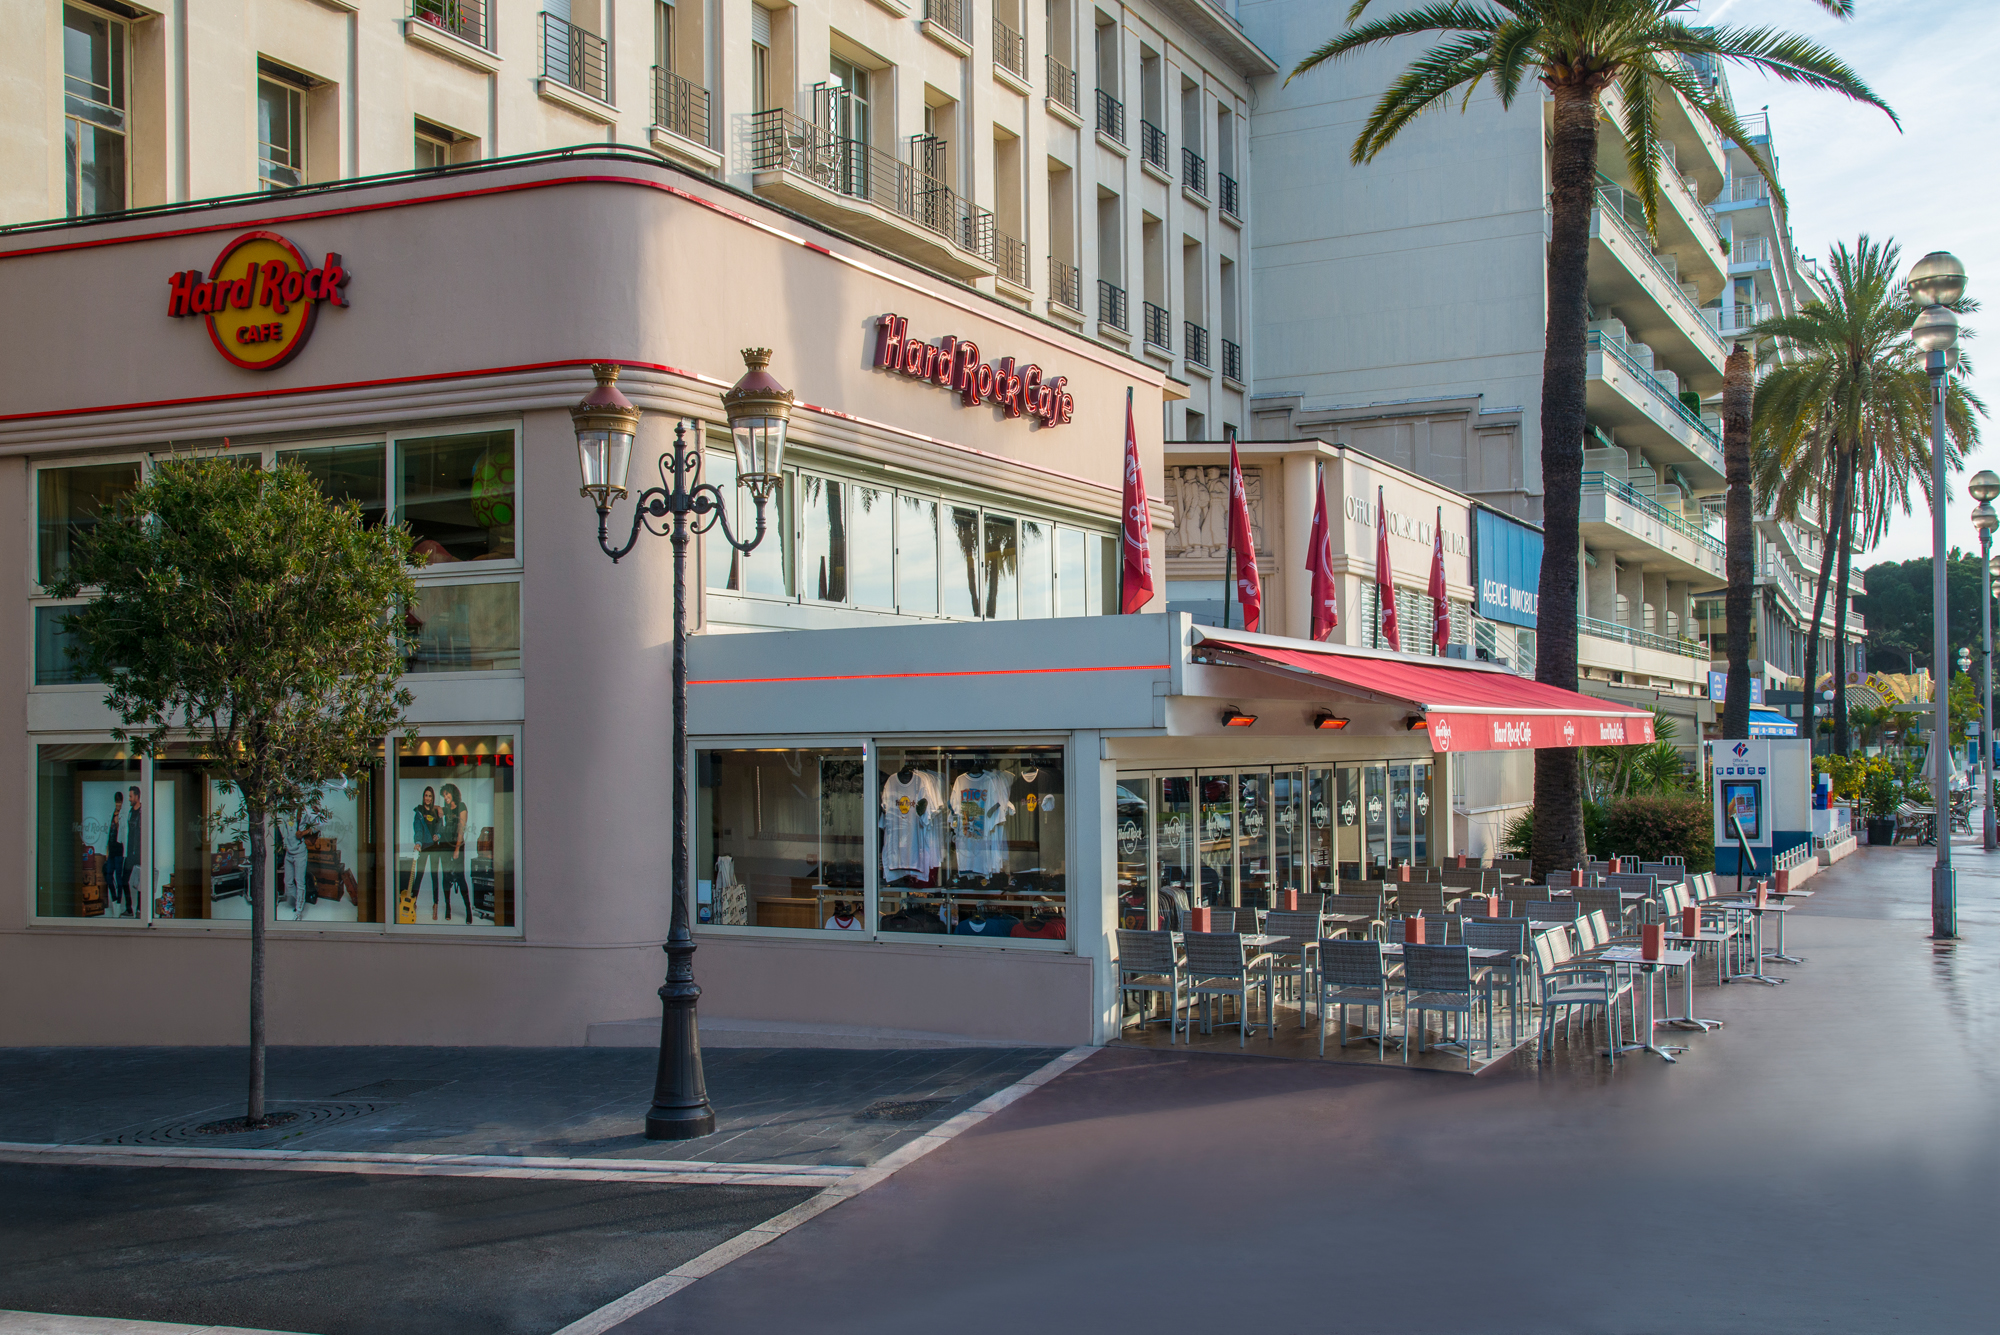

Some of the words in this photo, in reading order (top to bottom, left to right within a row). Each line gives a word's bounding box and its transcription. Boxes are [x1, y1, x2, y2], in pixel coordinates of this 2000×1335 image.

[168, 262, 258, 318] Hard
[260, 252, 346, 315] Rock
[236, 322, 283, 344] CAFE
[875, 313, 957, 387] Hard
[954, 340, 1020, 418] Rock
[1019, 364, 1073, 428] Cafe
[1346, 495, 1373, 527] OFFICE
[1418, 521, 1433, 546] NICE
[1435, 523, 1452, 553] ÔTE
[1483, 578, 1508, 607] AGENCE
[1493, 721, 1507, 743] Hard
[1507, 721, 1520, 747] Rock
[1520, 721, 1531, 747] Cafe
[72, 821, 91, 832] Hard
[91, 821, 109, 834] Rock
